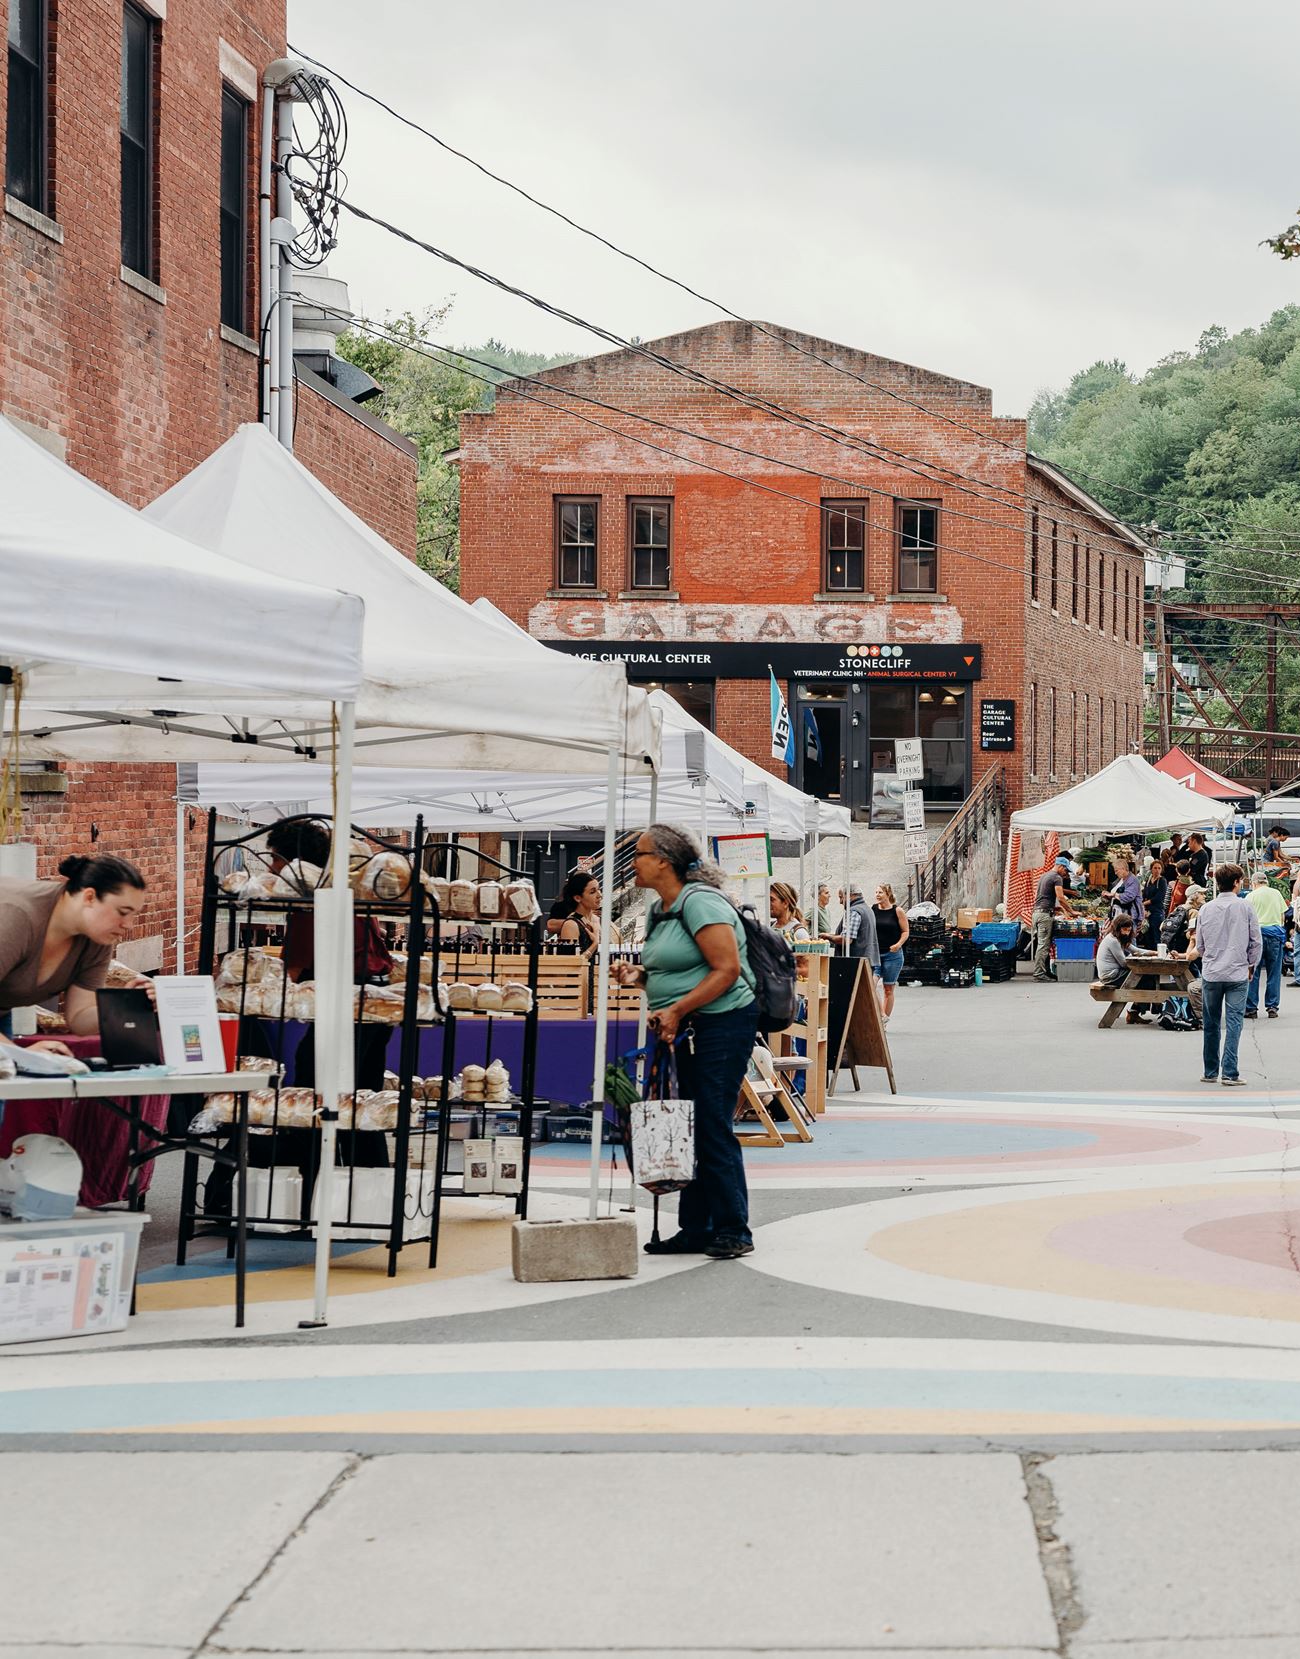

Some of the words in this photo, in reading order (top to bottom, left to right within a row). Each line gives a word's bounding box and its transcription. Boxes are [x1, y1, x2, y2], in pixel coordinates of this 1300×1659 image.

[555, 605, 933, 641] GARAGE
[600, 653, 662, 664] CULTURAL
[666, 654, 711, 664] CENTER
[839, 658, 912, 669] STONECLIFF
[904, 742, 912, 751] NO
[896, 753, 921, 764] OVERNIGHT
[899, 766, 921, 776] PARKING
